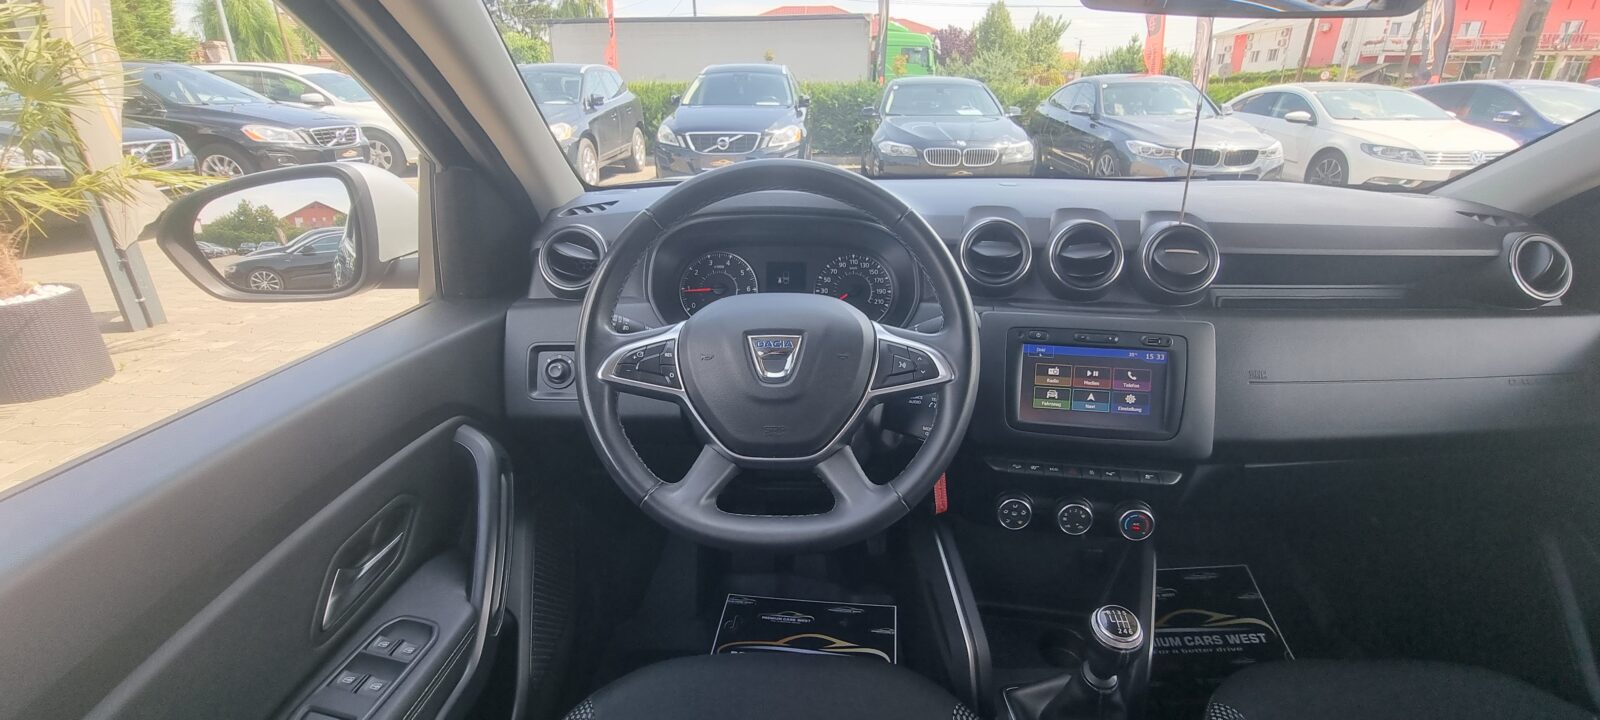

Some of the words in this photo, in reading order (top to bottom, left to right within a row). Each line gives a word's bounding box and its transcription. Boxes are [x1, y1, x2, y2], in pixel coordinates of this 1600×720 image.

[757, 340, 794, 348] DACIA
[1183, 634, 1224, 646] CARS
[1225, 632, 1267, 645] WEST
